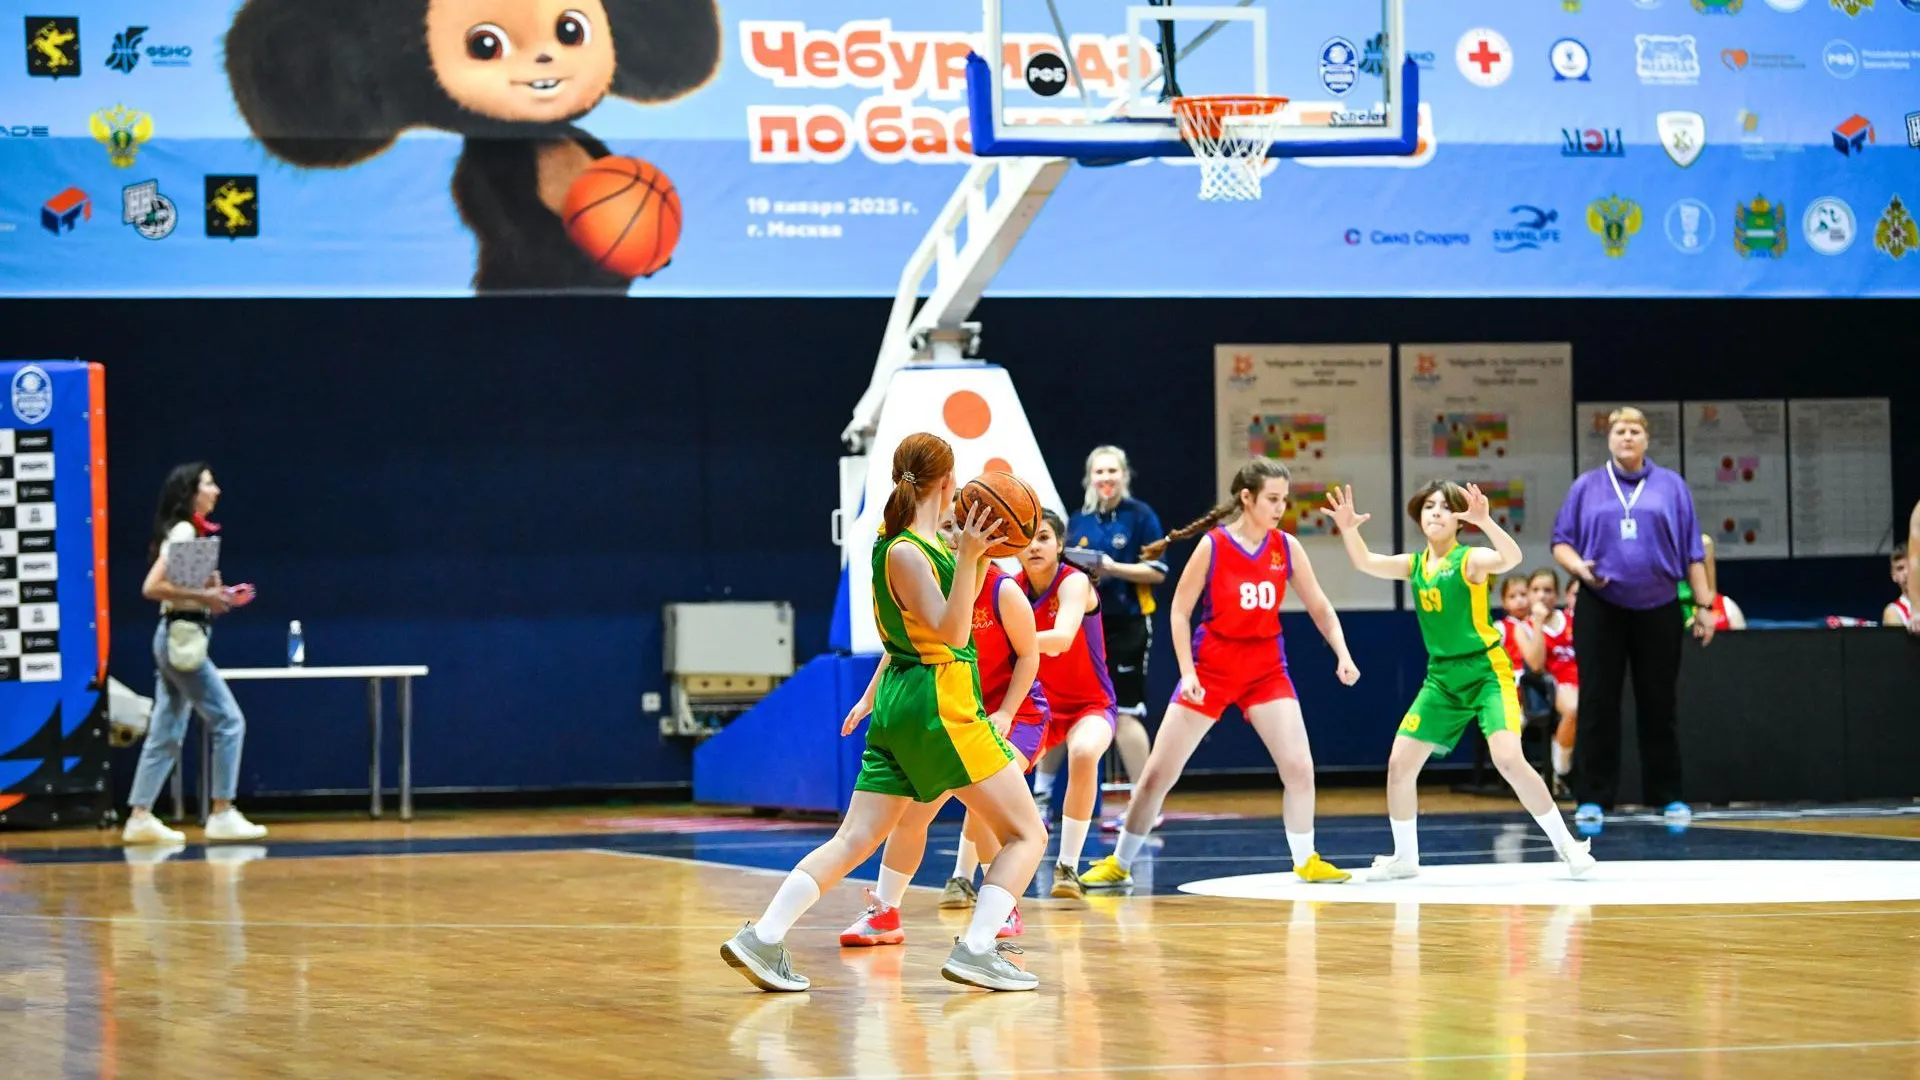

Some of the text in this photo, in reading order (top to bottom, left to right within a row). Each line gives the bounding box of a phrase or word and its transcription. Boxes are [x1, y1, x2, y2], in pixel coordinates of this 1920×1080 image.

[1029, 67, 1065, 82] РФБ
[759, 115, 846, 153] по
[747, 198, 919, 218] 19 января 2025 г.
[747, 221, 843, 237] г. Москва
[1239, 580, 1277, 611] 80
